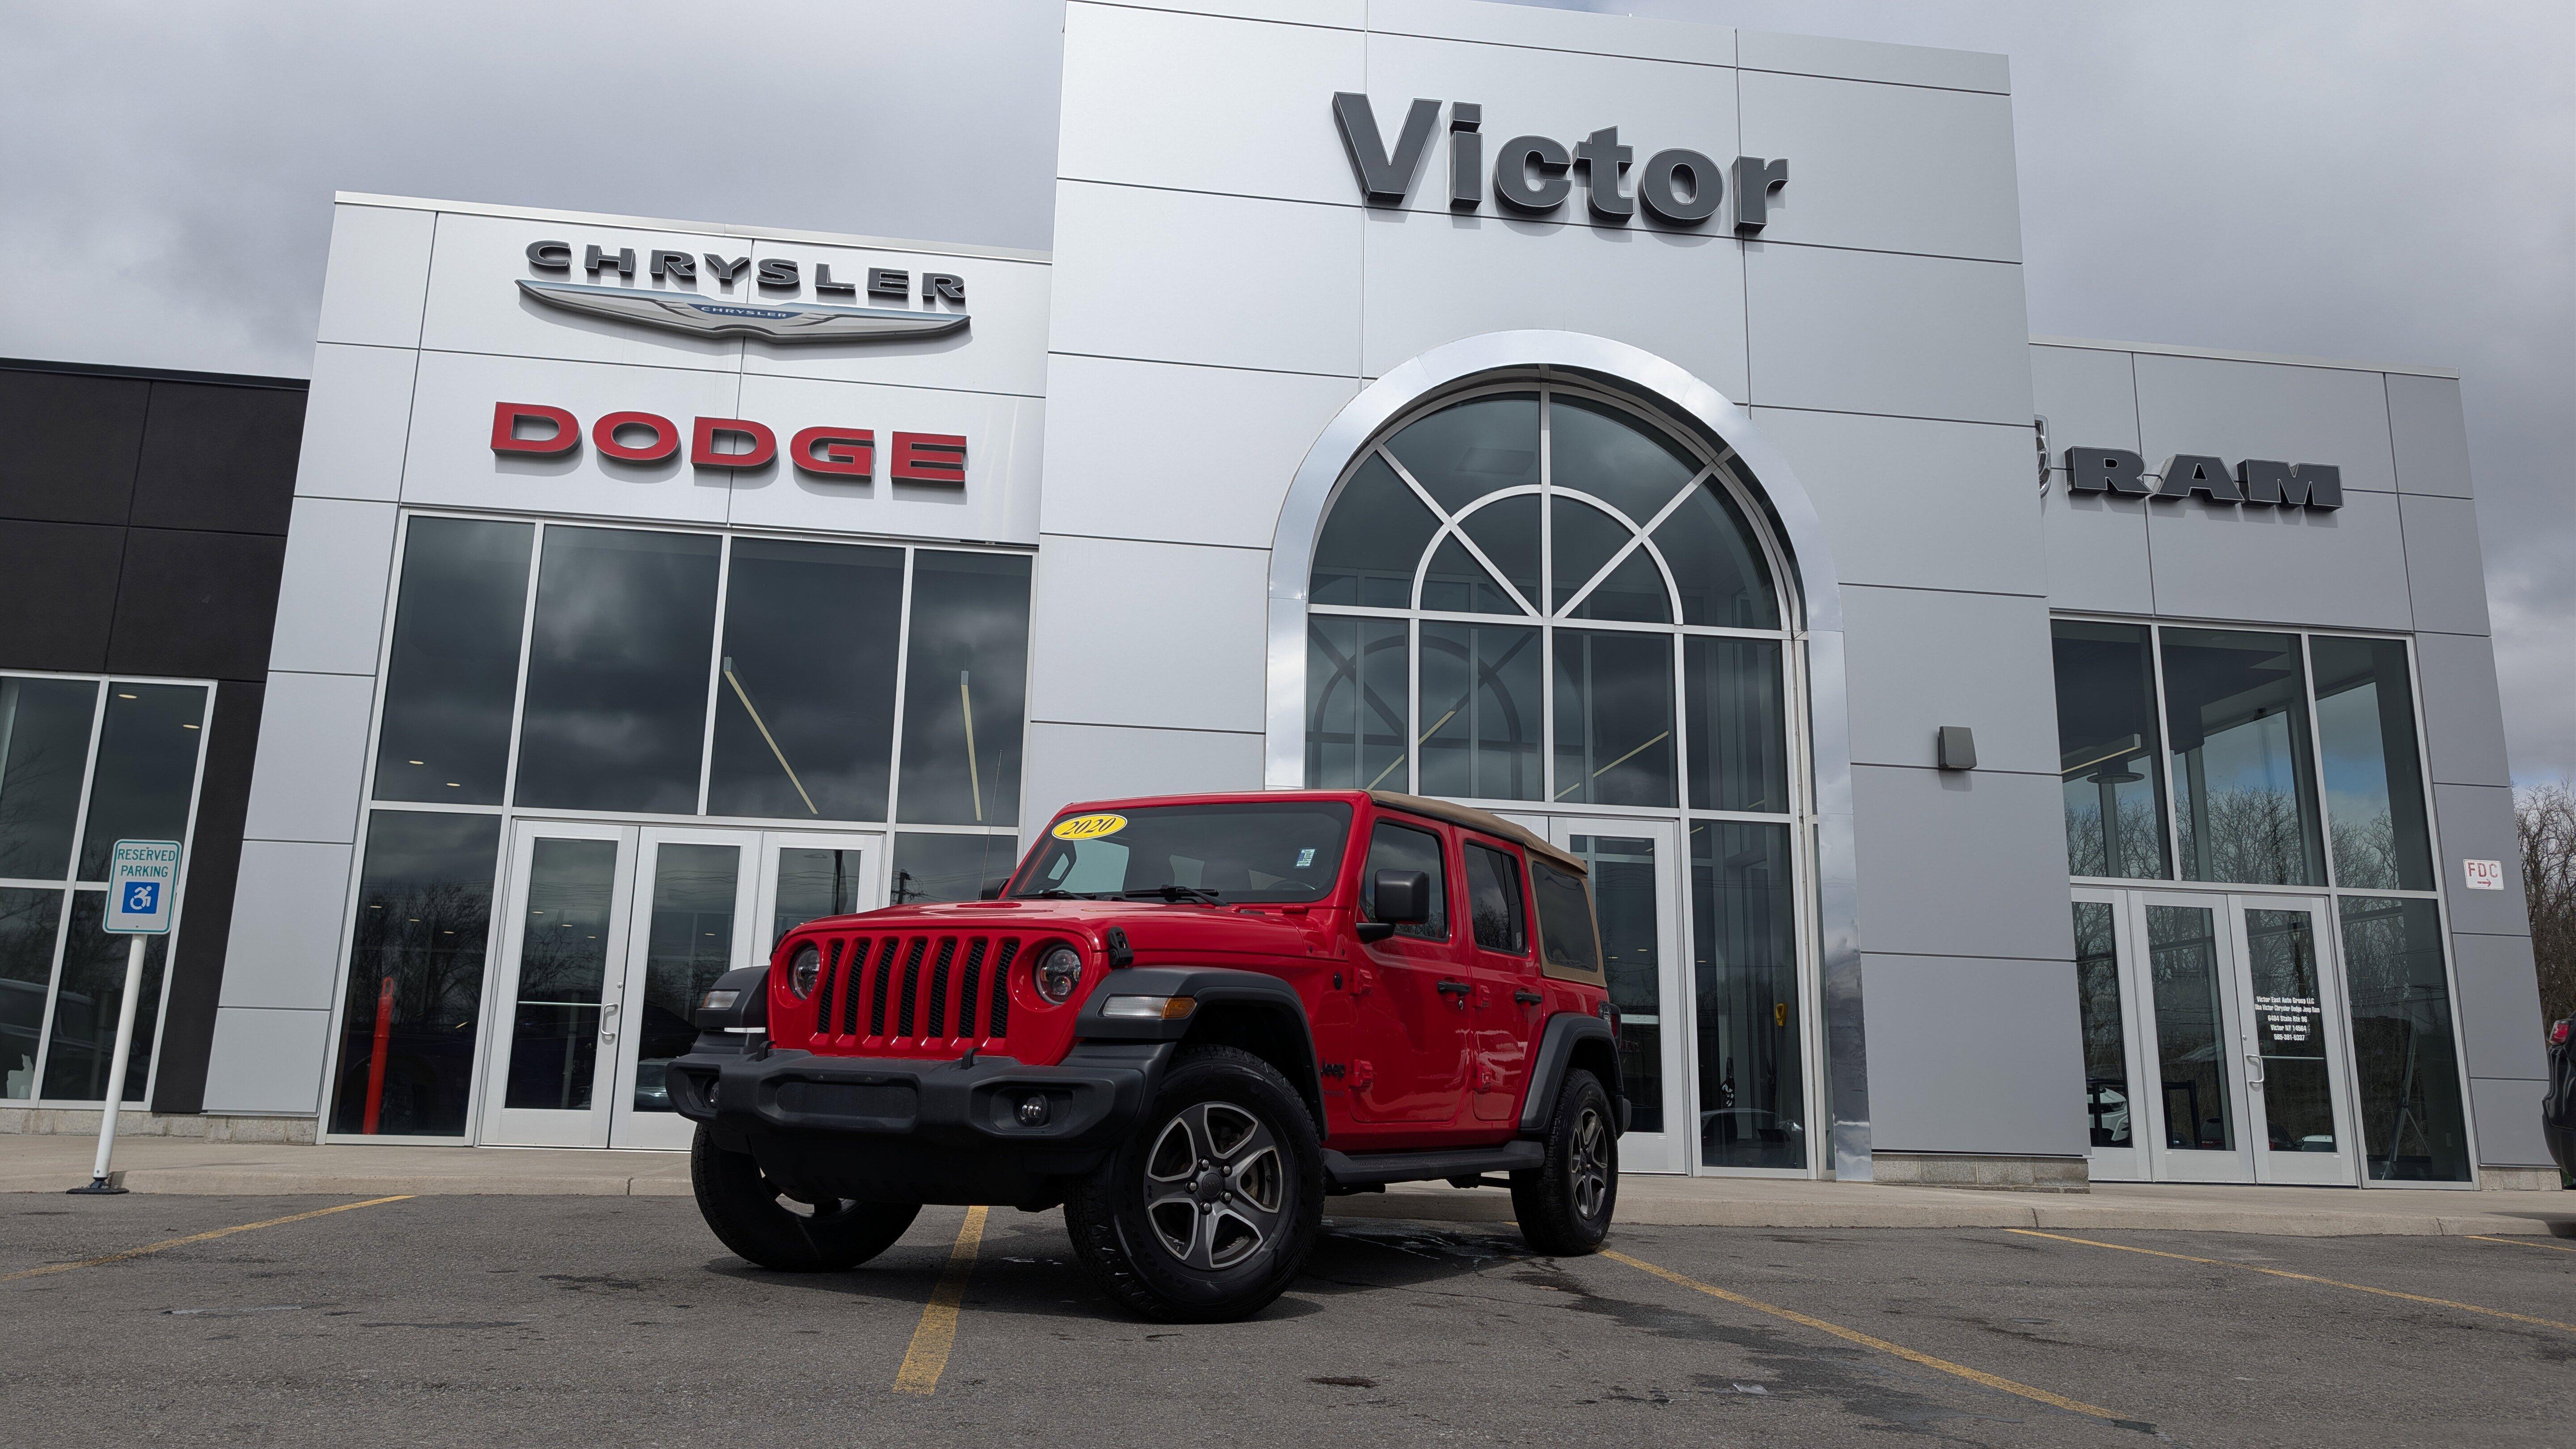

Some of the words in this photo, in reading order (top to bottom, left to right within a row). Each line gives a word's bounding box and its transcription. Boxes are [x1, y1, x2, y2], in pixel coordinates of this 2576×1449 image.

[1332, 91, 1788, 233] Victor
[525, 240, 966, 302] CHRYSLER
[701, 307, 787, 318] CHRYSLER
[491, 402, 967, 488] DODGE
[2064, 445, 2344, 512] RAM
[1060, 818, 1116, 836] 2020
[117, 848, 176, 861] RESERVED
[120, 865, 169, 877] PARKING
[2467, 862, 2498, 878] FDC
[1320, 1058, 1346, 1081] Jeep
